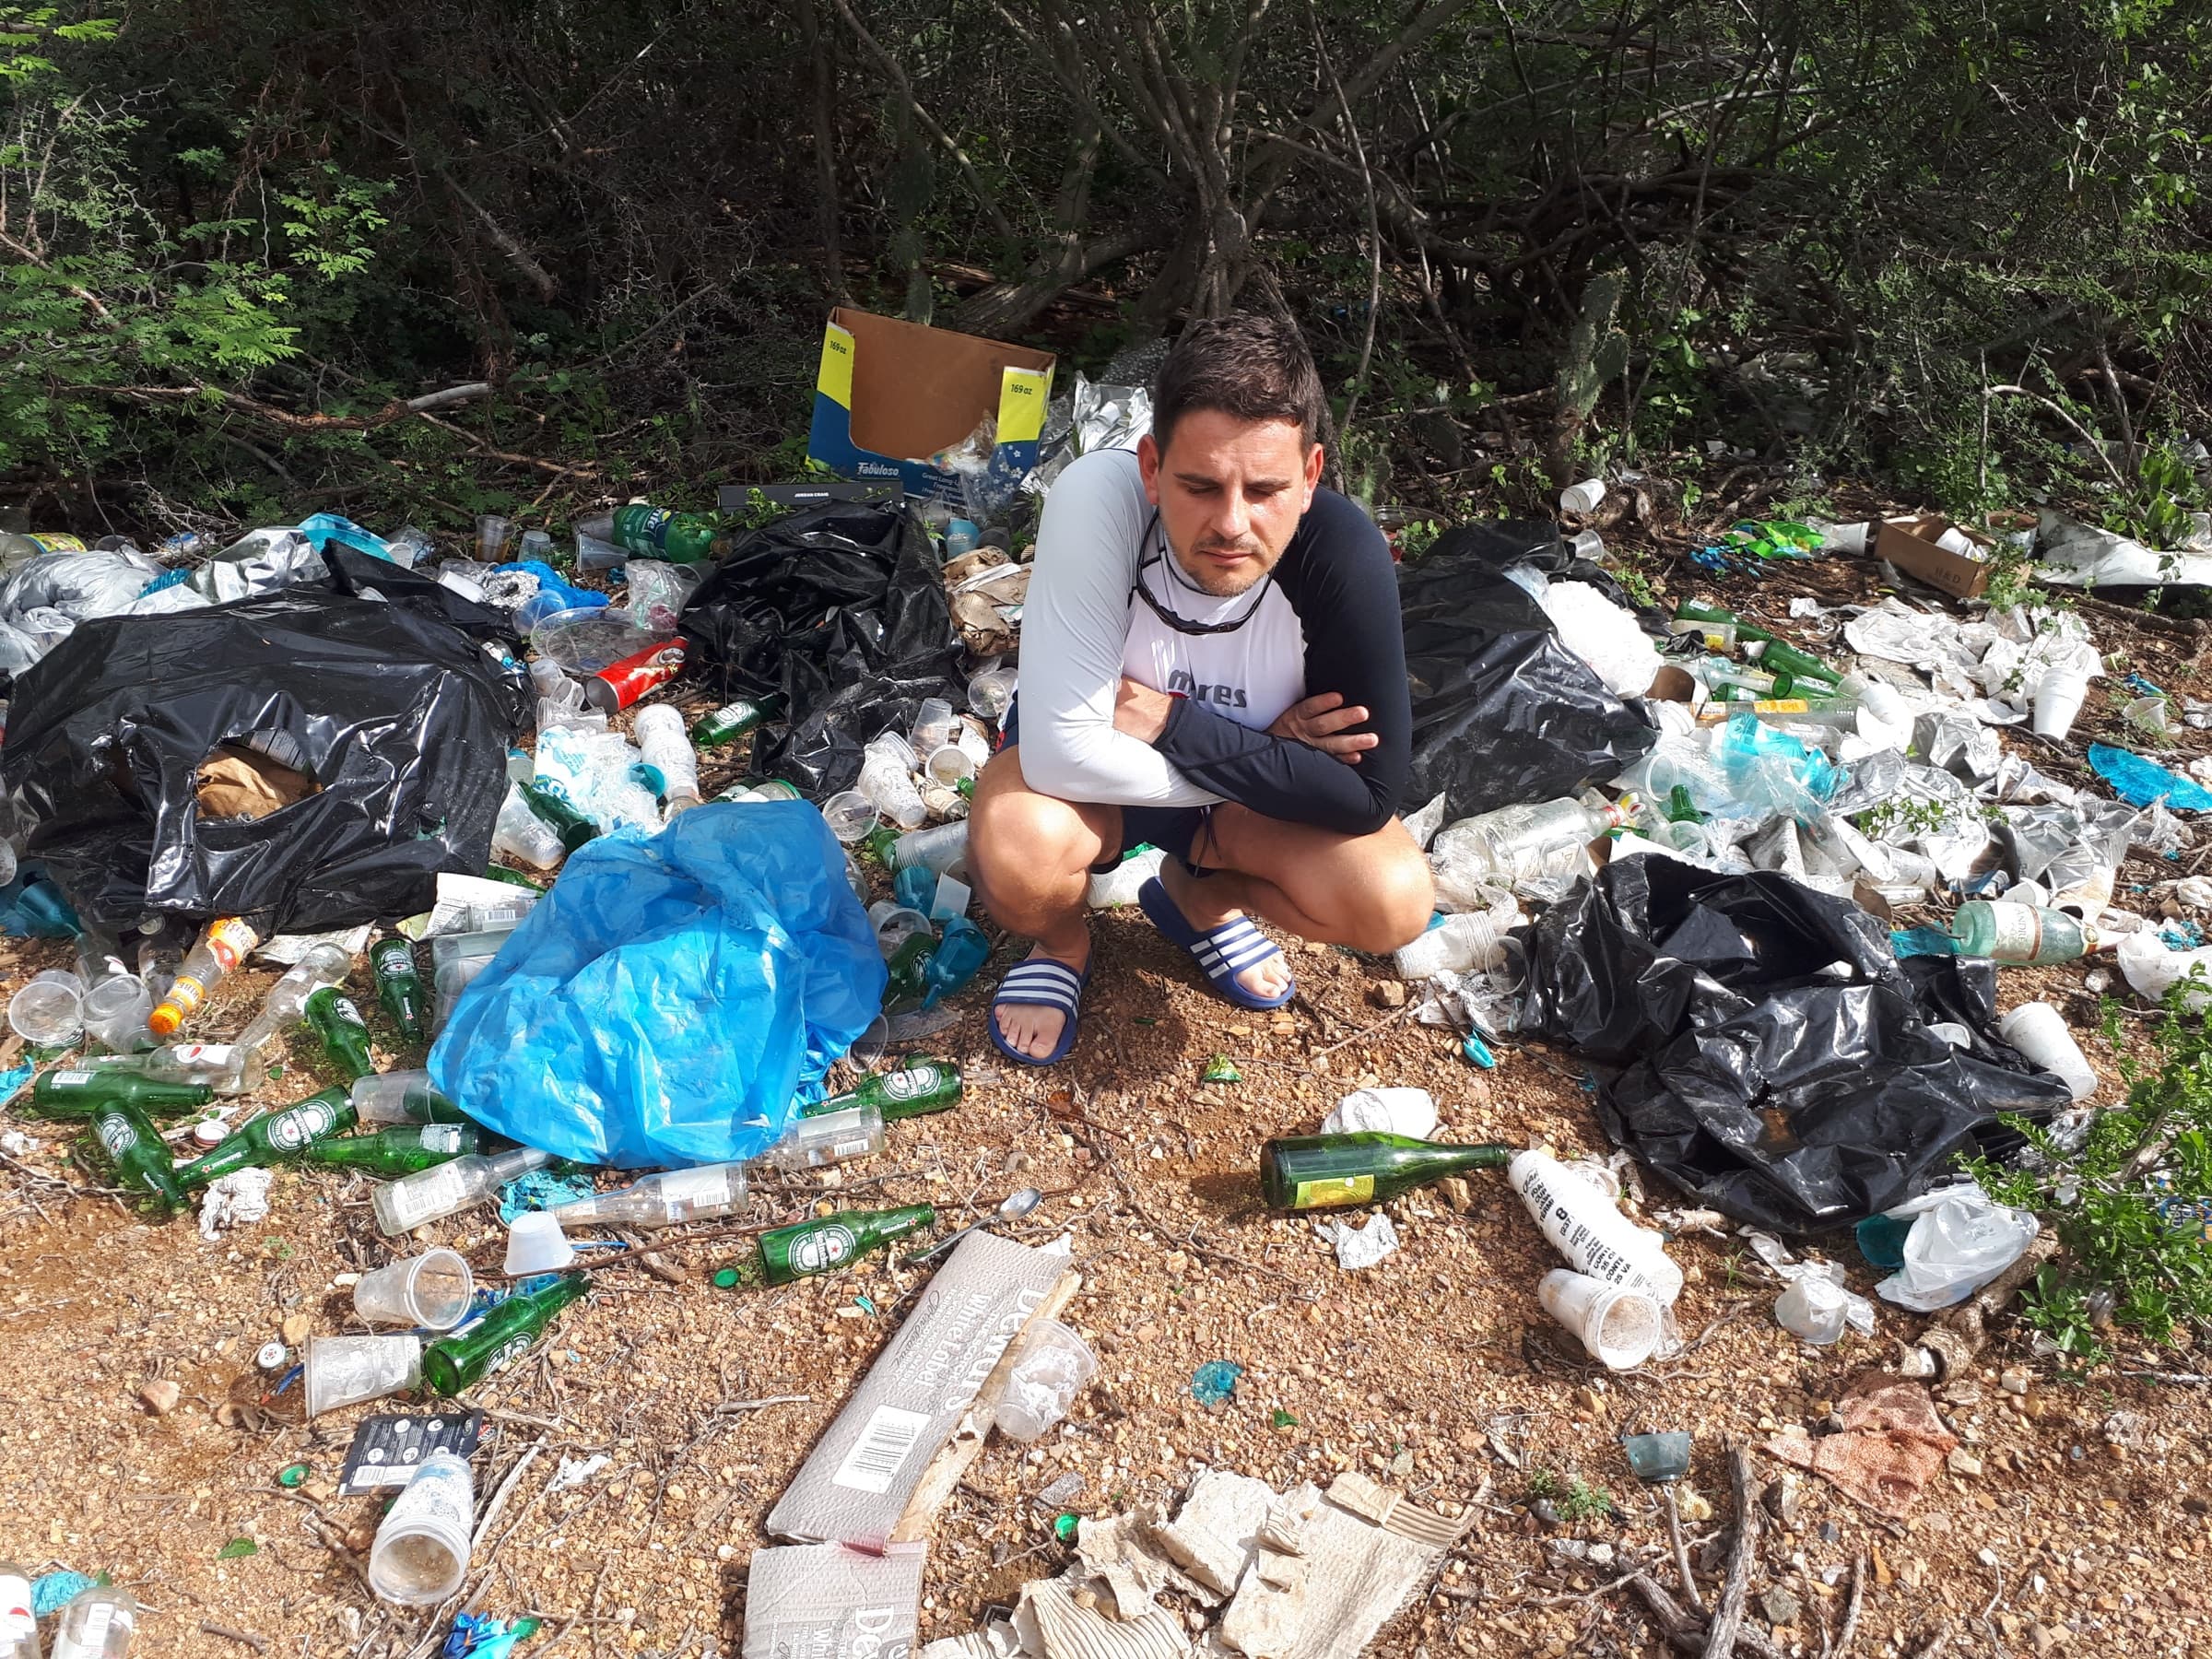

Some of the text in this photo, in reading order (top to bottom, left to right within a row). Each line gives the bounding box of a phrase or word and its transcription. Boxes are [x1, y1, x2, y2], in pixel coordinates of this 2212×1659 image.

[830, 340, 840, 352] 169
[1010, 383, 1033, 395] 169 oz
[857, 462, 899, 476] Fabuloso
[1168, 669, 1247, 708] mres
[1555, 1206, 1569, 1220] 8
[1613, 1273, 1622, 1285] 25
[913, 1291, 992, 1388] White Label
